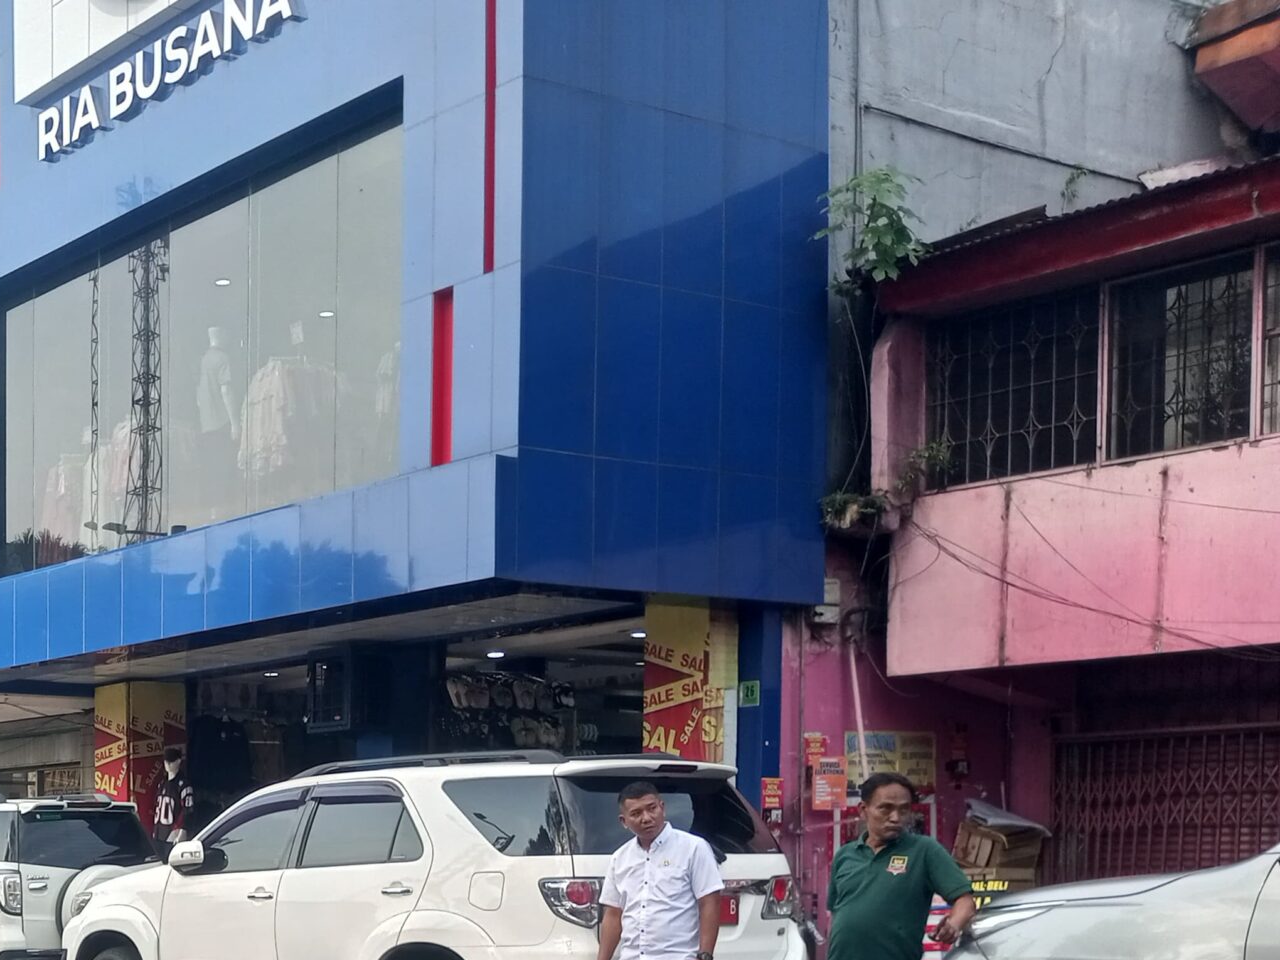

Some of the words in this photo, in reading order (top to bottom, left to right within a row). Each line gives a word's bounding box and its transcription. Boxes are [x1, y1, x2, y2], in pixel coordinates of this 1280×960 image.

[37, 85, 100, 161] RIA
[108, 0, 292, 120] BUSANA
[643, 641, 675, 664] SALE
[744, 685, 755, 698] 26
[679, 707, 702, 745] SALE
